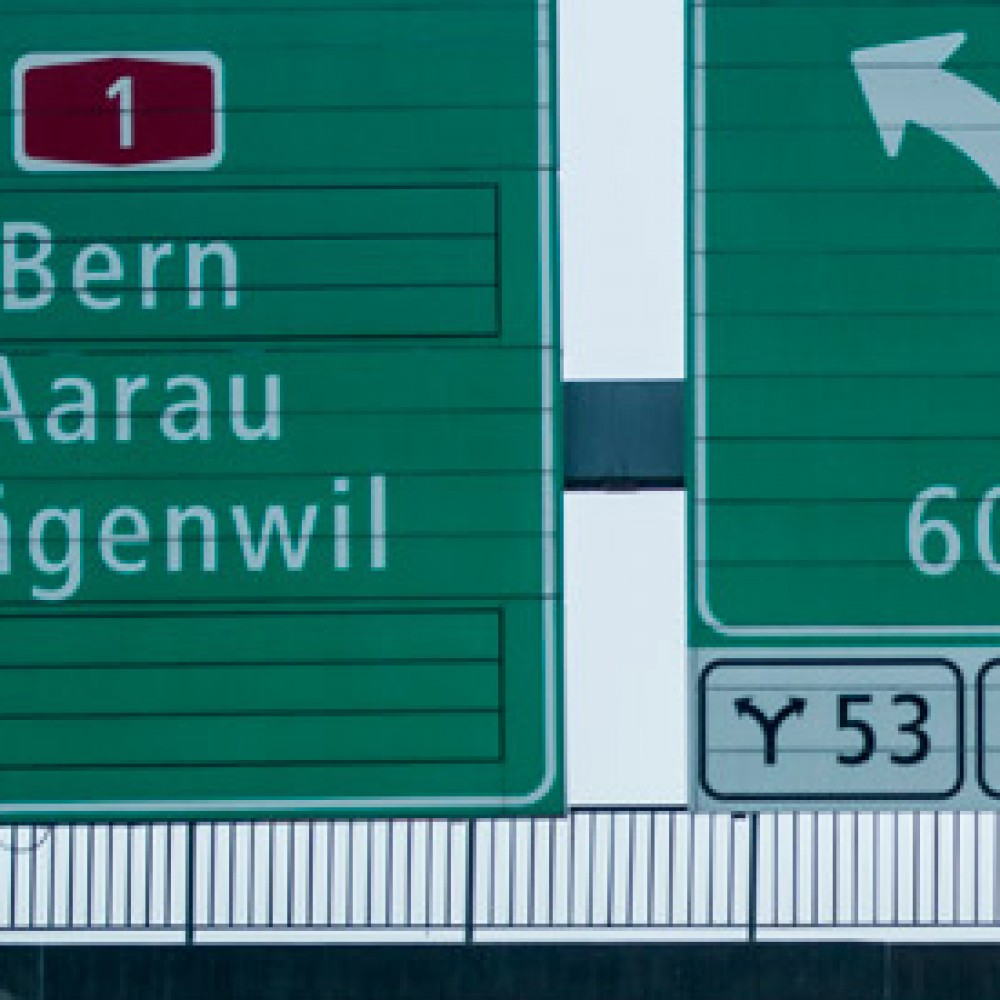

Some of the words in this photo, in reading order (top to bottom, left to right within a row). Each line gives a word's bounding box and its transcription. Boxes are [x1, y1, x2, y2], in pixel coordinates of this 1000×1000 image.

[105, 75, 134, 148] 1
[2, 221, 238, 309] Bern
[0, 475, 386, 601] genwil
[836, 694, 931, 765] 53
